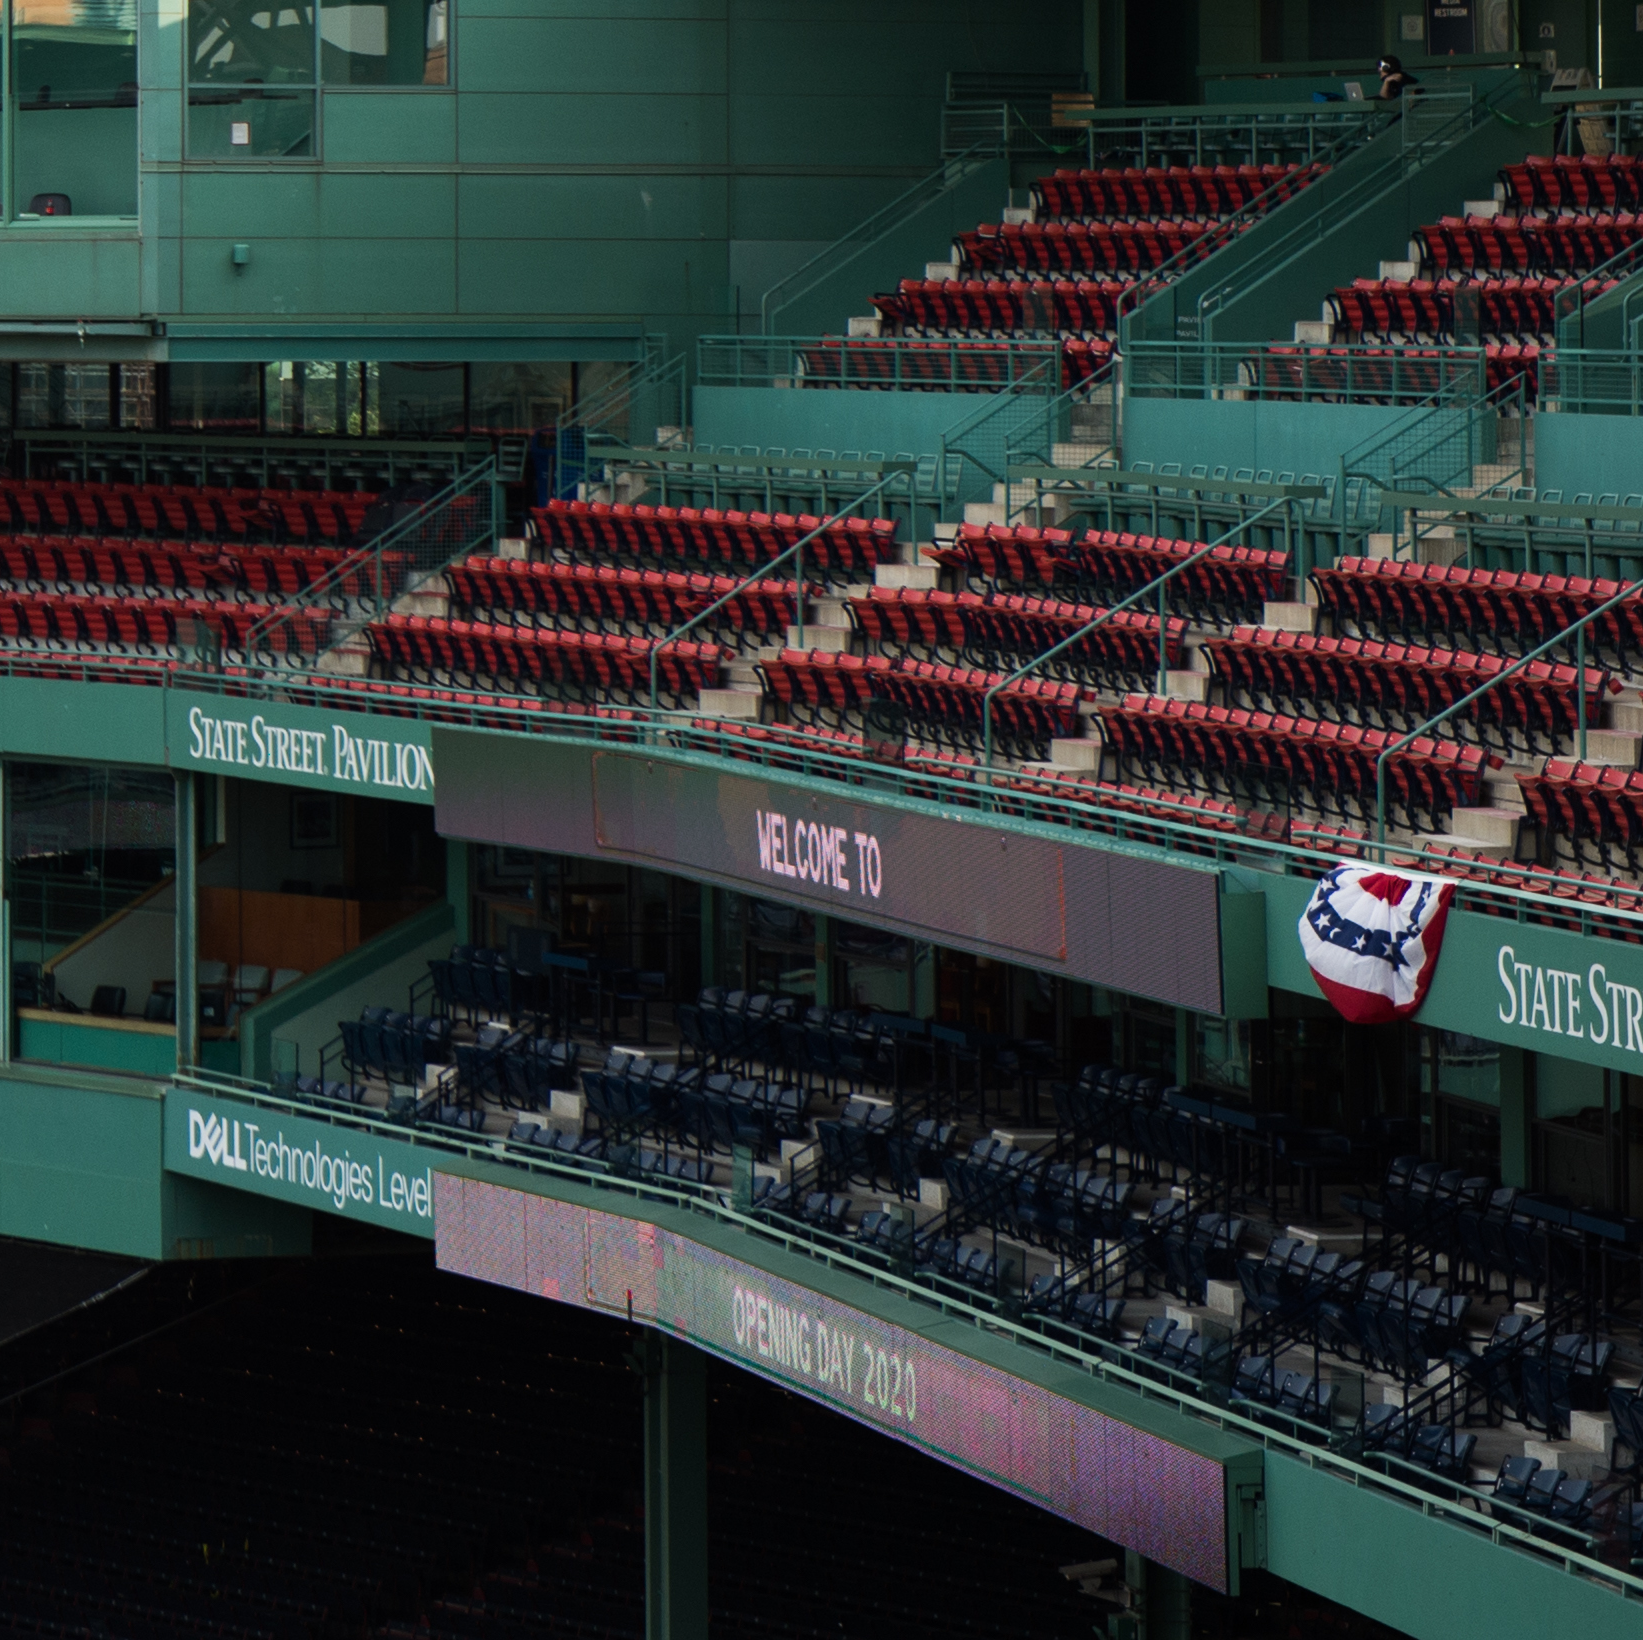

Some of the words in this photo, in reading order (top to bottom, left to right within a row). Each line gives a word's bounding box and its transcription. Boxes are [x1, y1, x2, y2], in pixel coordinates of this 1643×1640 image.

[1434, 7, 1467, 17] RESTROOM
[189, 706, 248, 764] STATE
[251, 715, 326, 775] STREET
[332, 724, 435, 790] PAVILION
[756, 809, 850, 892] WELCOME
[854, 831, 882, 898] TO
[1498, 945, 1584, 1038] STATE
[189, 1109, 247, 1171] DELL
[244, 1123, 373, 1209] Technologies
[378, 1150, 432, 1218] Level
[732, 1285, 811, 1375] OPENING
[817, 1319, 855, 1394] DAY
[864, 1340, 916, 1422] 2020
